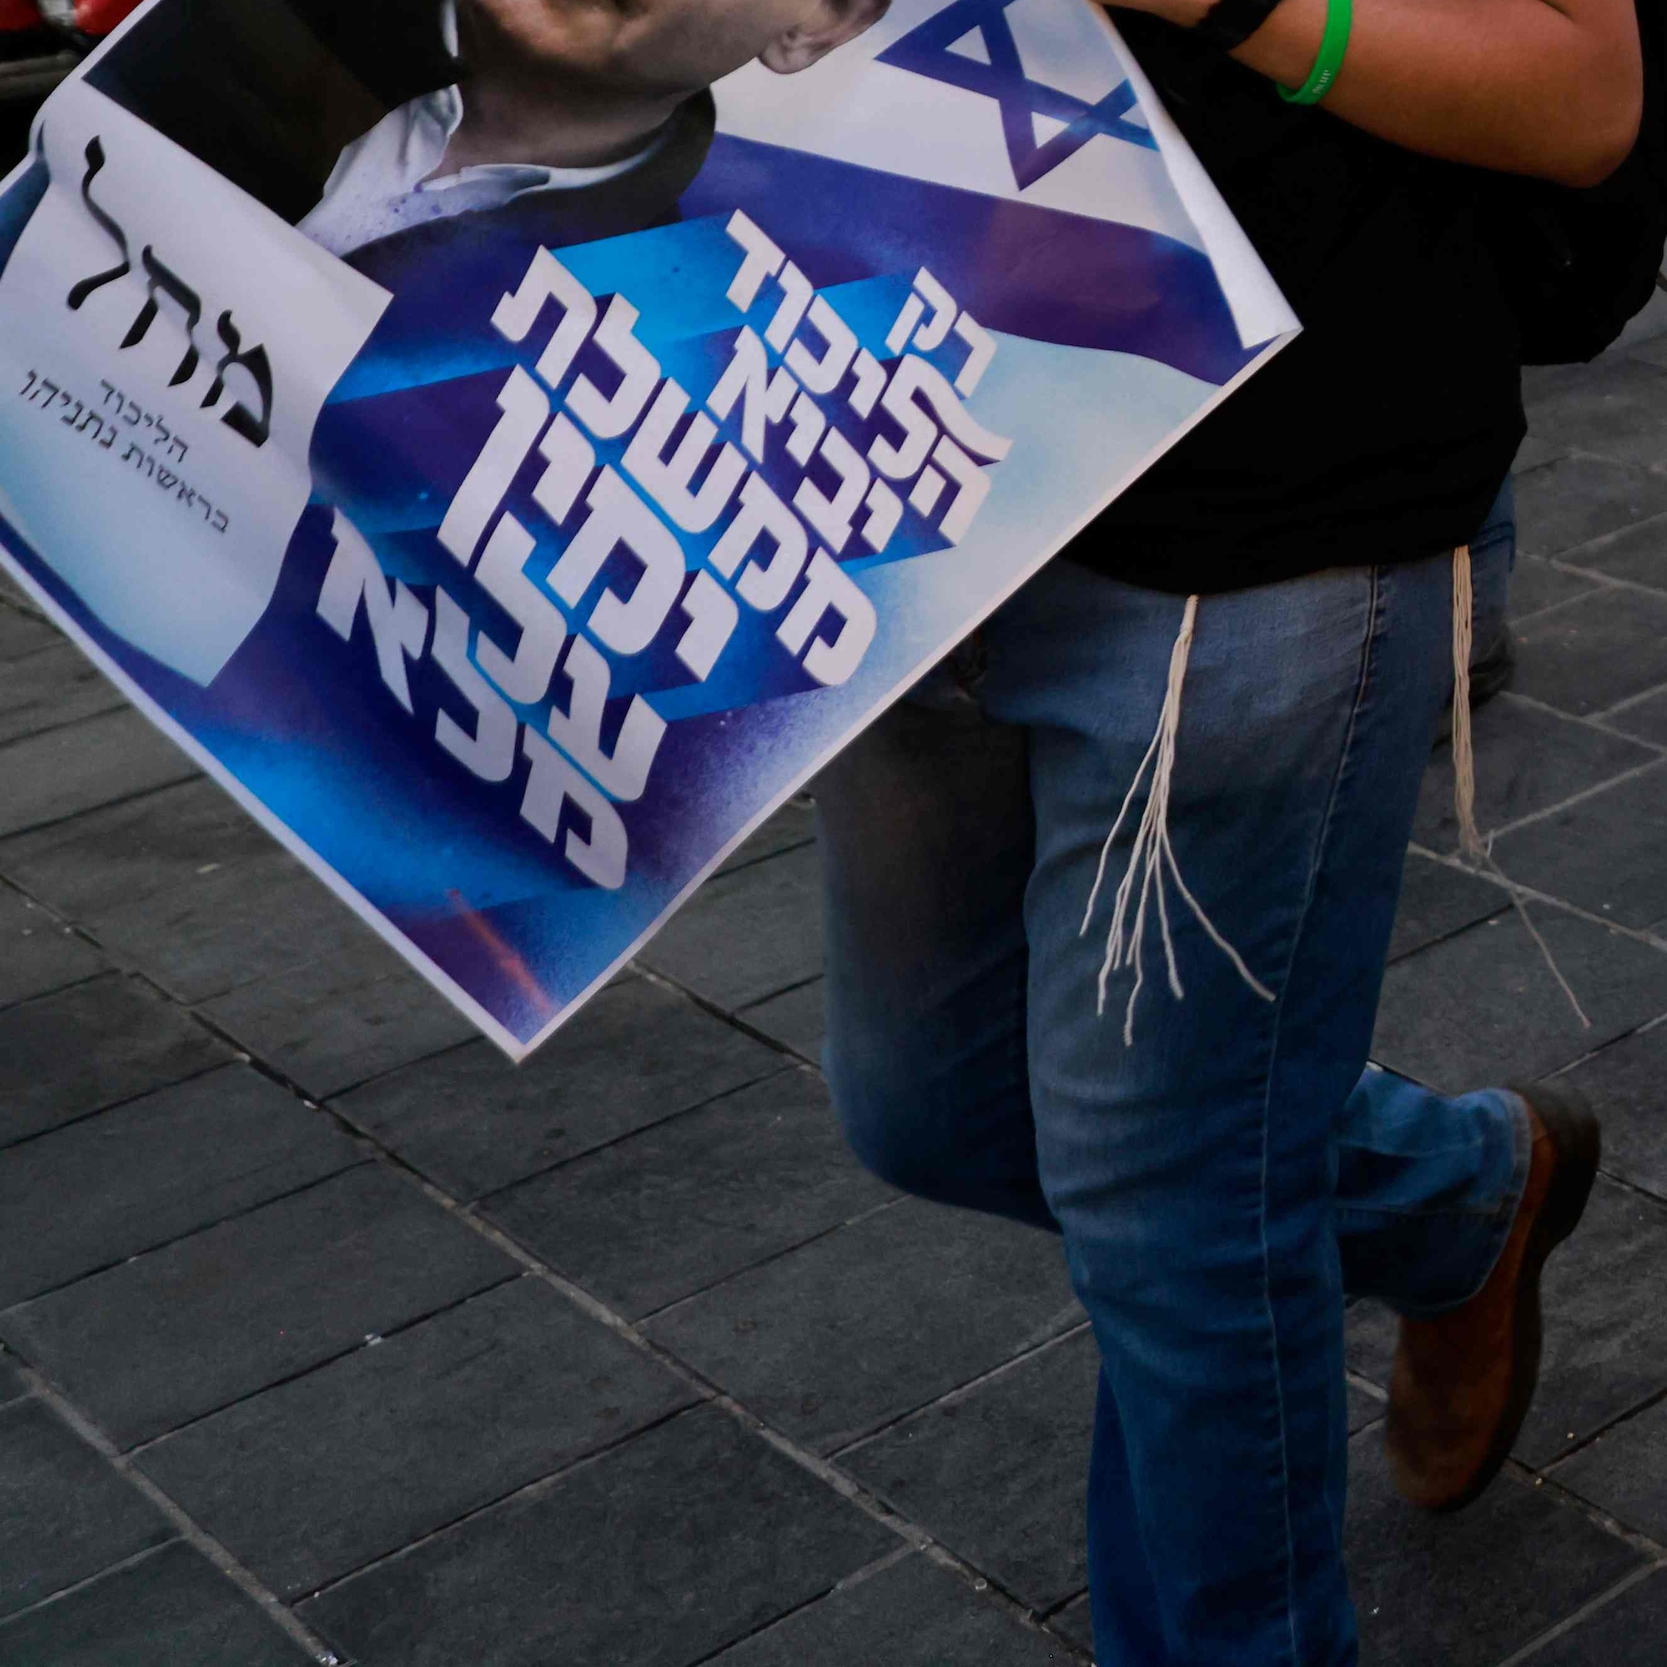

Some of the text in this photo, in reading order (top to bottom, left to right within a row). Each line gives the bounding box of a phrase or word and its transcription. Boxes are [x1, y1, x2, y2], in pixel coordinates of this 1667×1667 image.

[67, 134, 273, 448] מחל
[101, 379, 189, 463] הליכוד
[706, 325, 904, 555] יביא
[725, 208, 1013, 547] הליכוד
[885, 266, 999, 398] רק
[19, 369, 229, 533] בראשות נתניהו
[436, 363, 740, 683] ימין
[490, 244, 877, 688] ממשלת
[315, 505, 630, 891] מלא
[472, 512, 668, 802] על
